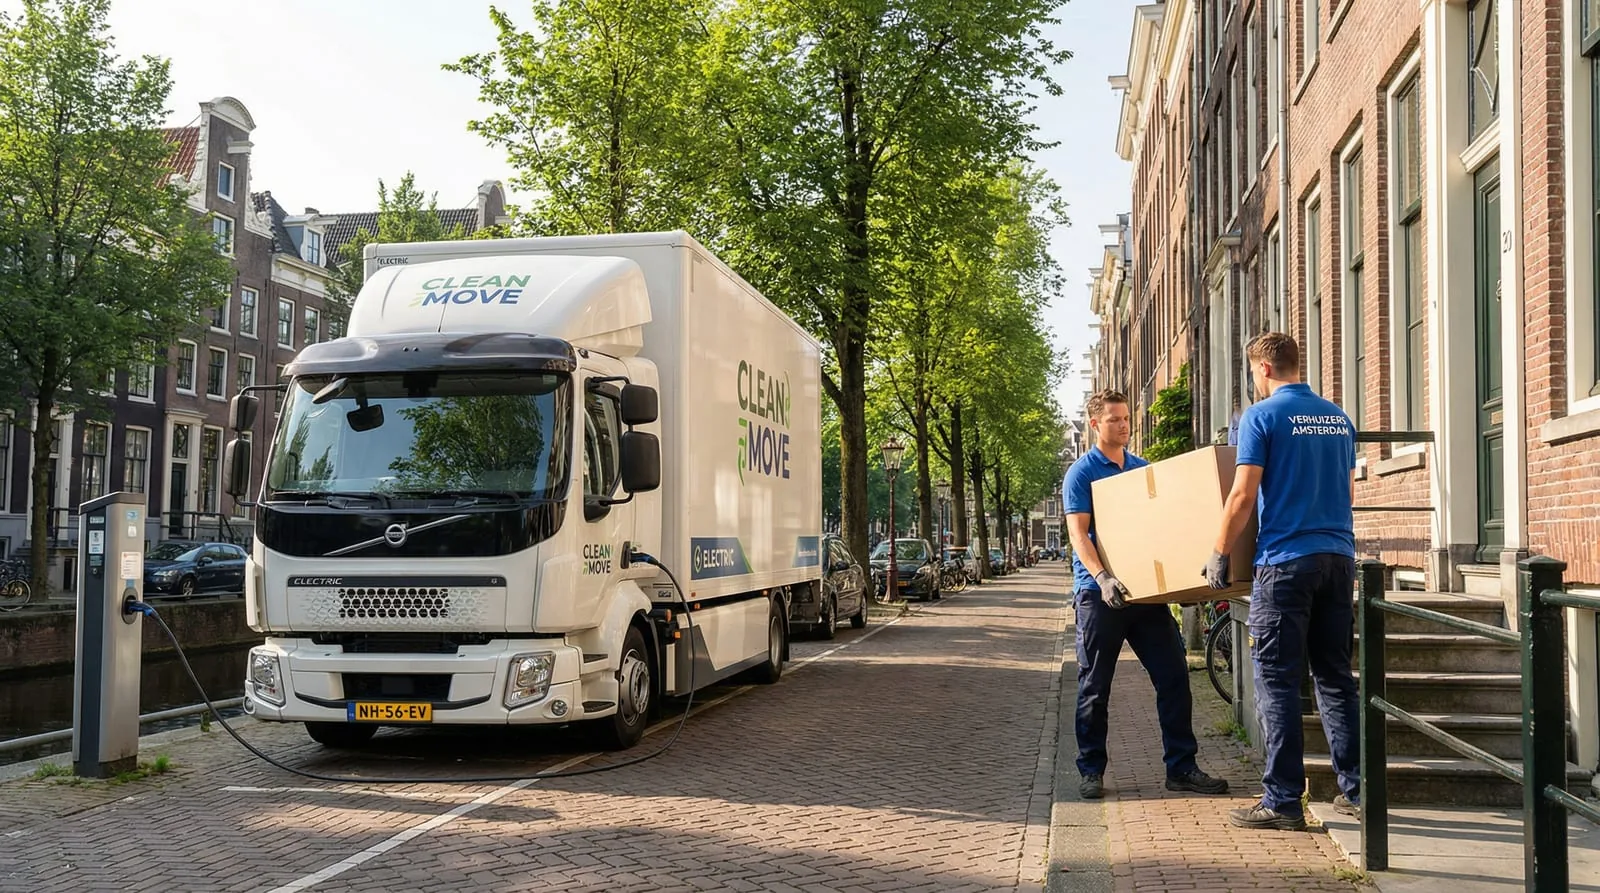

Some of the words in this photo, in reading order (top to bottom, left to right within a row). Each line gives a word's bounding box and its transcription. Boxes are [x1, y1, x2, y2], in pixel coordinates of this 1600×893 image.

[422, 275, 531, 290] CLEAN
[422, 289, 522, 306] MOVE
[737, 360, 785, 426] CLEAN
[1288, 415, 1347, 425] VERHUIZERS
[1292, 425, 1350, 435] AMSTERDAM
[748, 420, 790, 480] MOVE
[583, 544, 611, 559] CLEAN
[703, 548, 734, 568] ELECTRIC
[588, 560, 611, 575] MOVE
[359, 704, 427, 719] NH-56-EV
